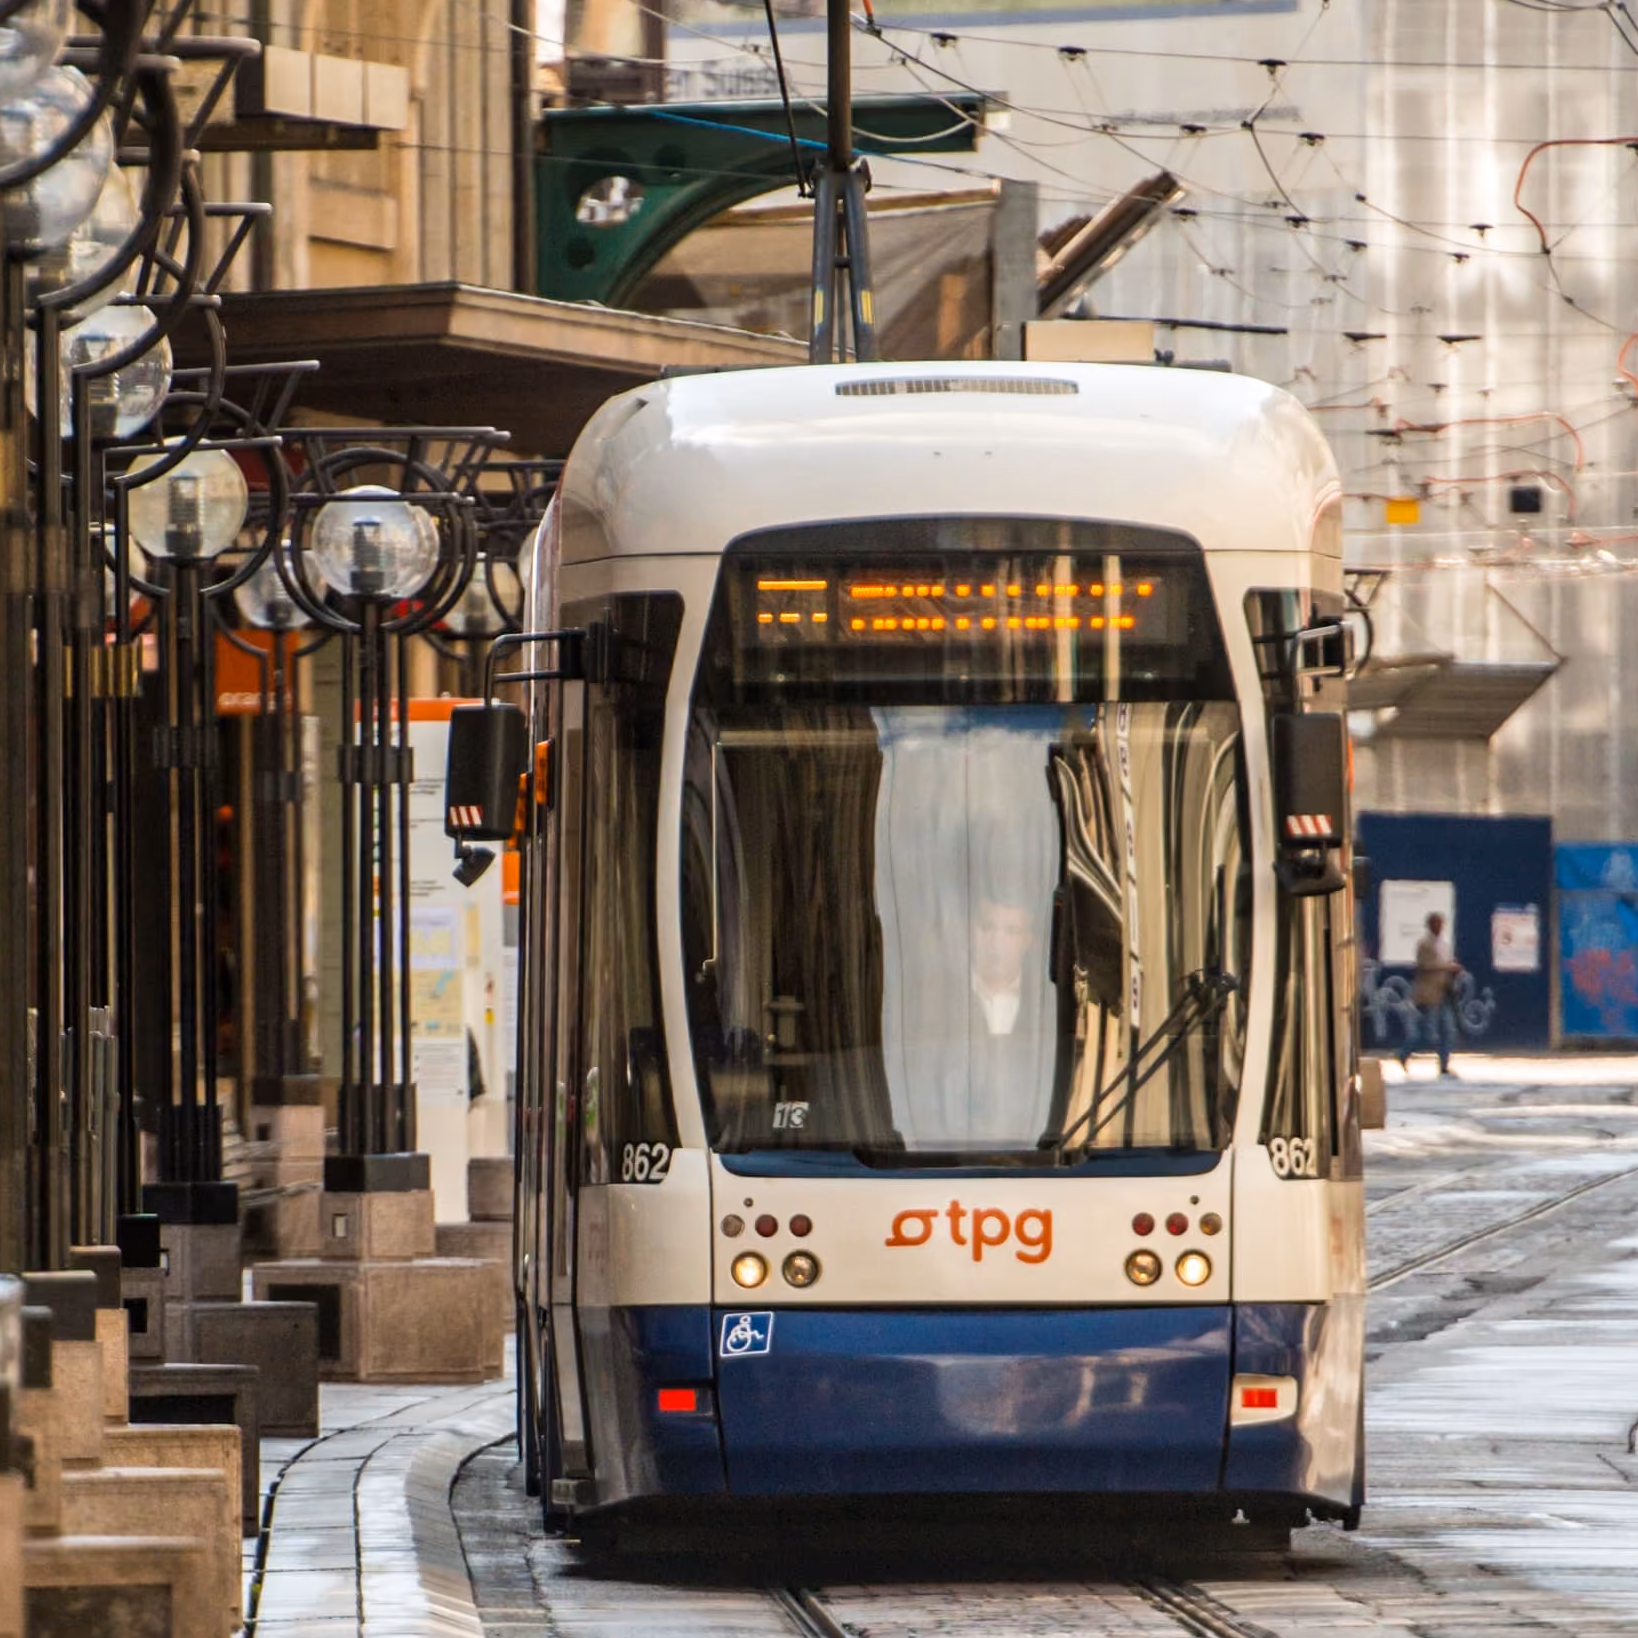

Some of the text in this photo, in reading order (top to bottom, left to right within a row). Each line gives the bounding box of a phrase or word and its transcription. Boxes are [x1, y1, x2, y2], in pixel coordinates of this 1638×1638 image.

[621, 1141, 670, 1182] 862
[1269, 1136, 1319, 1178] 862
[945, 1198, 1053, 1264] tpg
